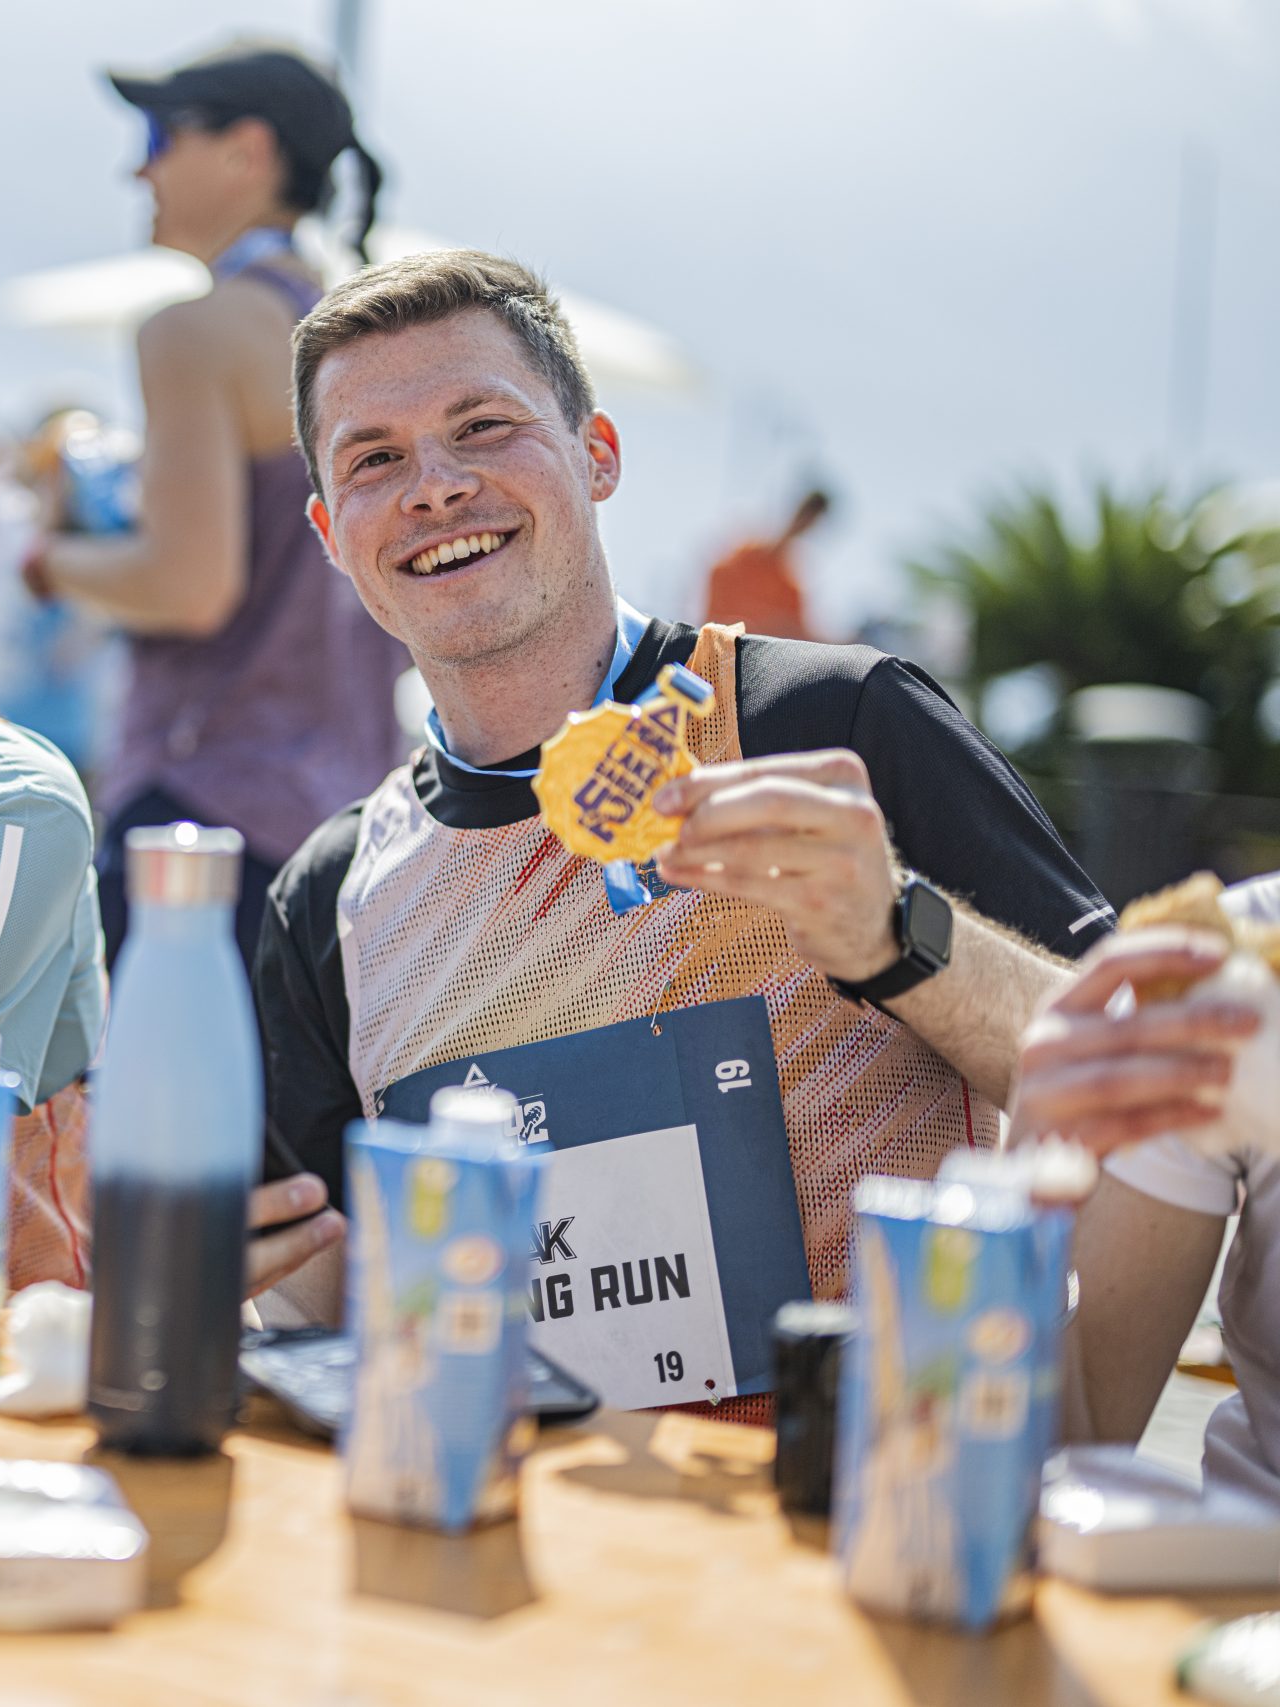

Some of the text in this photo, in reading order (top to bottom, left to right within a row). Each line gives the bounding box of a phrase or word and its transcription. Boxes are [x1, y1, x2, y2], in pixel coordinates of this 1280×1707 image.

[714, 1059, 752, 1094] 19
[528, 1215, 578, 1265] AK
[526, 1252, 691, 1323] NG RUN
[653, 1350, 684, 1383] 19
